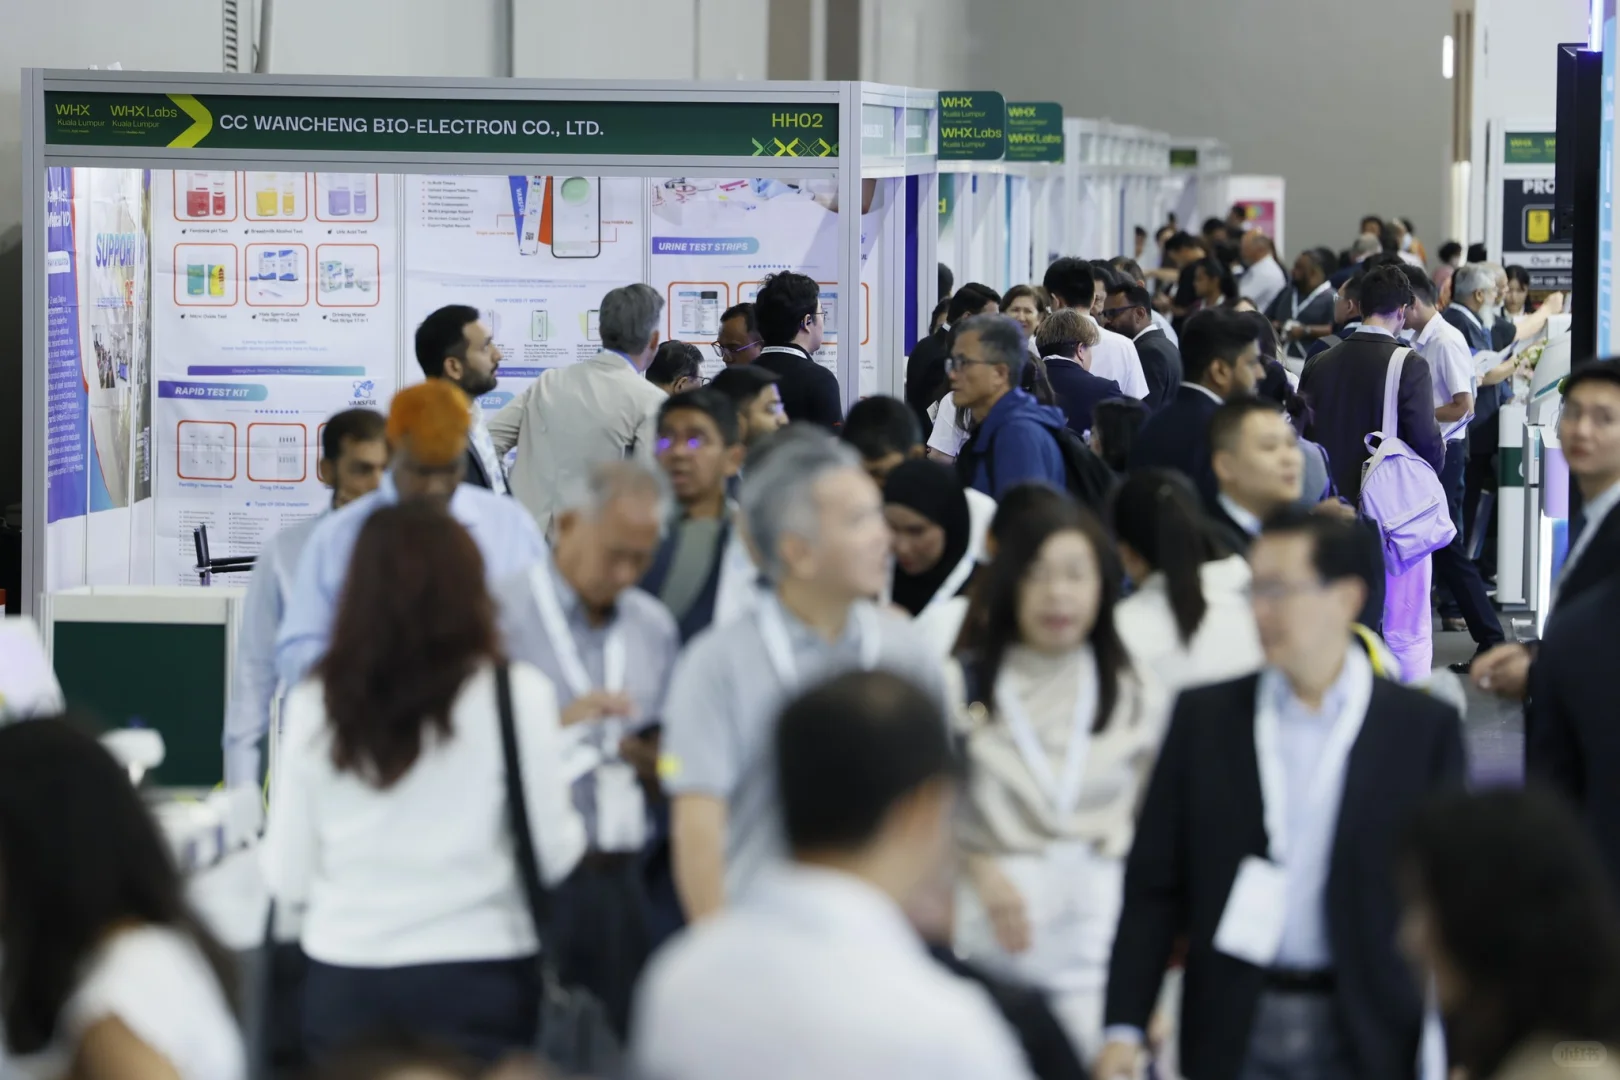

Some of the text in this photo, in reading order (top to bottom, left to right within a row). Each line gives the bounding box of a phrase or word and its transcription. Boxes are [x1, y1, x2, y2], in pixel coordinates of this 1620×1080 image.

[941, 97, 973, 108] WHX
[55, 104, 90, 116] WHX
[110, 105, 178, 118] WHX Labs
[57, 118, 105, 128] Kuala Lumpur
[112, 120, 160, 129] Kuala Lumpur
[219, 114, 604, 137] CC WANCHENG BIO-ELECTRON CO., LTD.
[772, 113, 823, 128] HH02
[941, 127, 1002, 138] WHX Labs
[1036, 134, 1061, 144] Labs
[658, 242, 749, 252] URINE TEST STRIPS
[175, 386, 249, 397] RAPID TEST KIT
